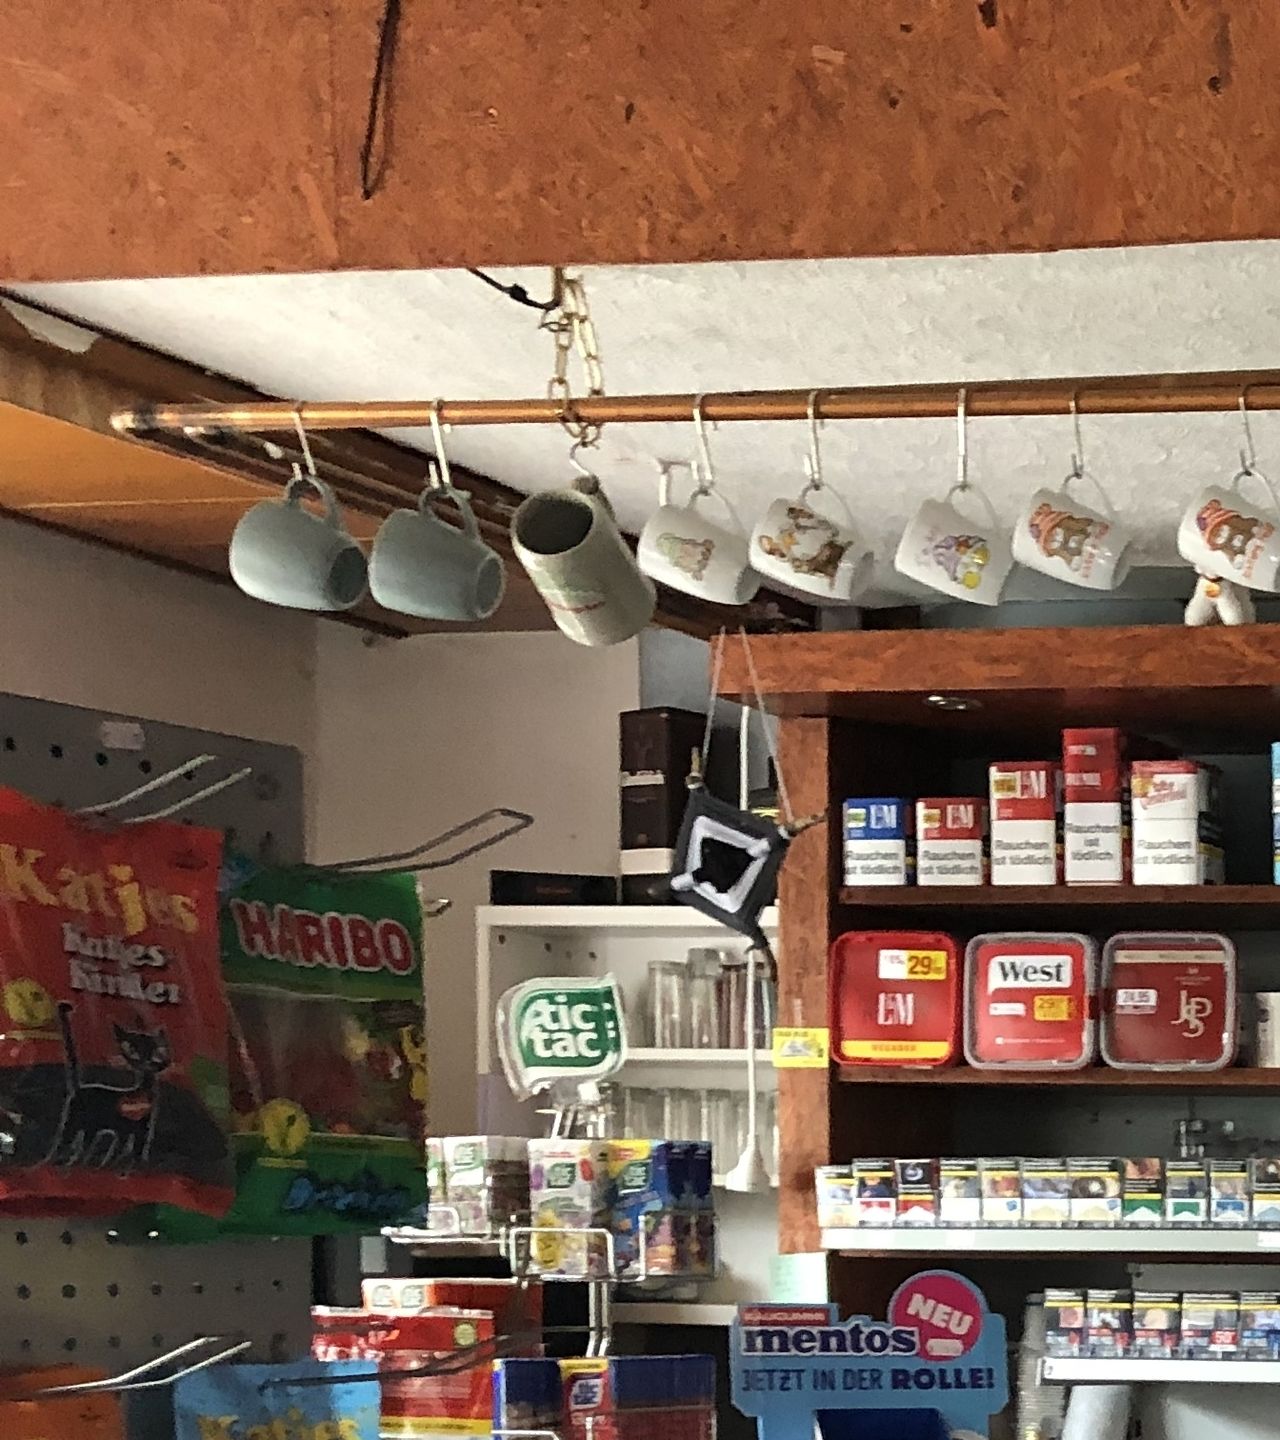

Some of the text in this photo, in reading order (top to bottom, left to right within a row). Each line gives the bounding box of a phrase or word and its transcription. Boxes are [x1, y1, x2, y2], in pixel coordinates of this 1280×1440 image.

[230, 896, 416, 976] HARIBO
[998, 959, 1064, 983] West
[533, 1026, 601, 1059] tac
[906, 1292, 974, 1336] NEU
[744, 1322, 917, 1354] mentos
[742, 1367, 996, 1393] JETZT IN DER ROLLE!
